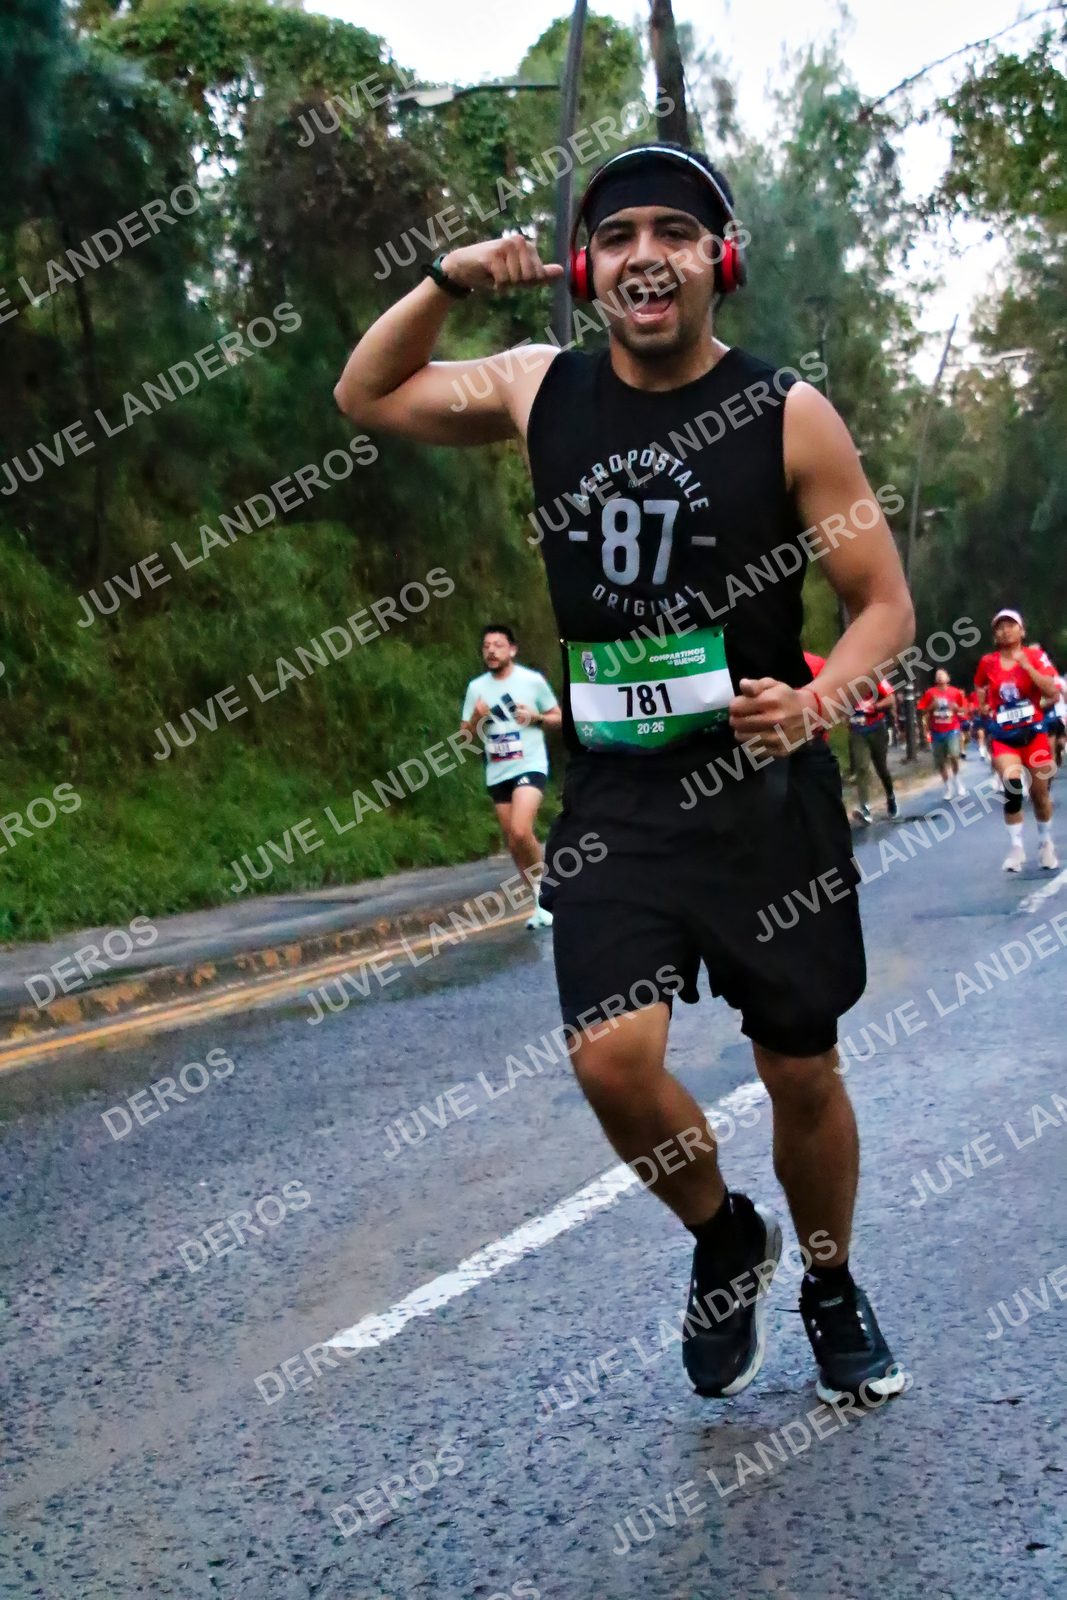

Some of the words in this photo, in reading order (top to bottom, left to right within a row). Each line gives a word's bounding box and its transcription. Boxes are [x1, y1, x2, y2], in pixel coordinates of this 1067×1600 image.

[573, 449, 709, 512] AEROPOSTALE
[601, 498, 680, 586] 87
[592, 584, 700, 616] ORIGINAL
[649, 647, 705, 663] COMPARTIMOS
[618, 682, 673, 718] 781
